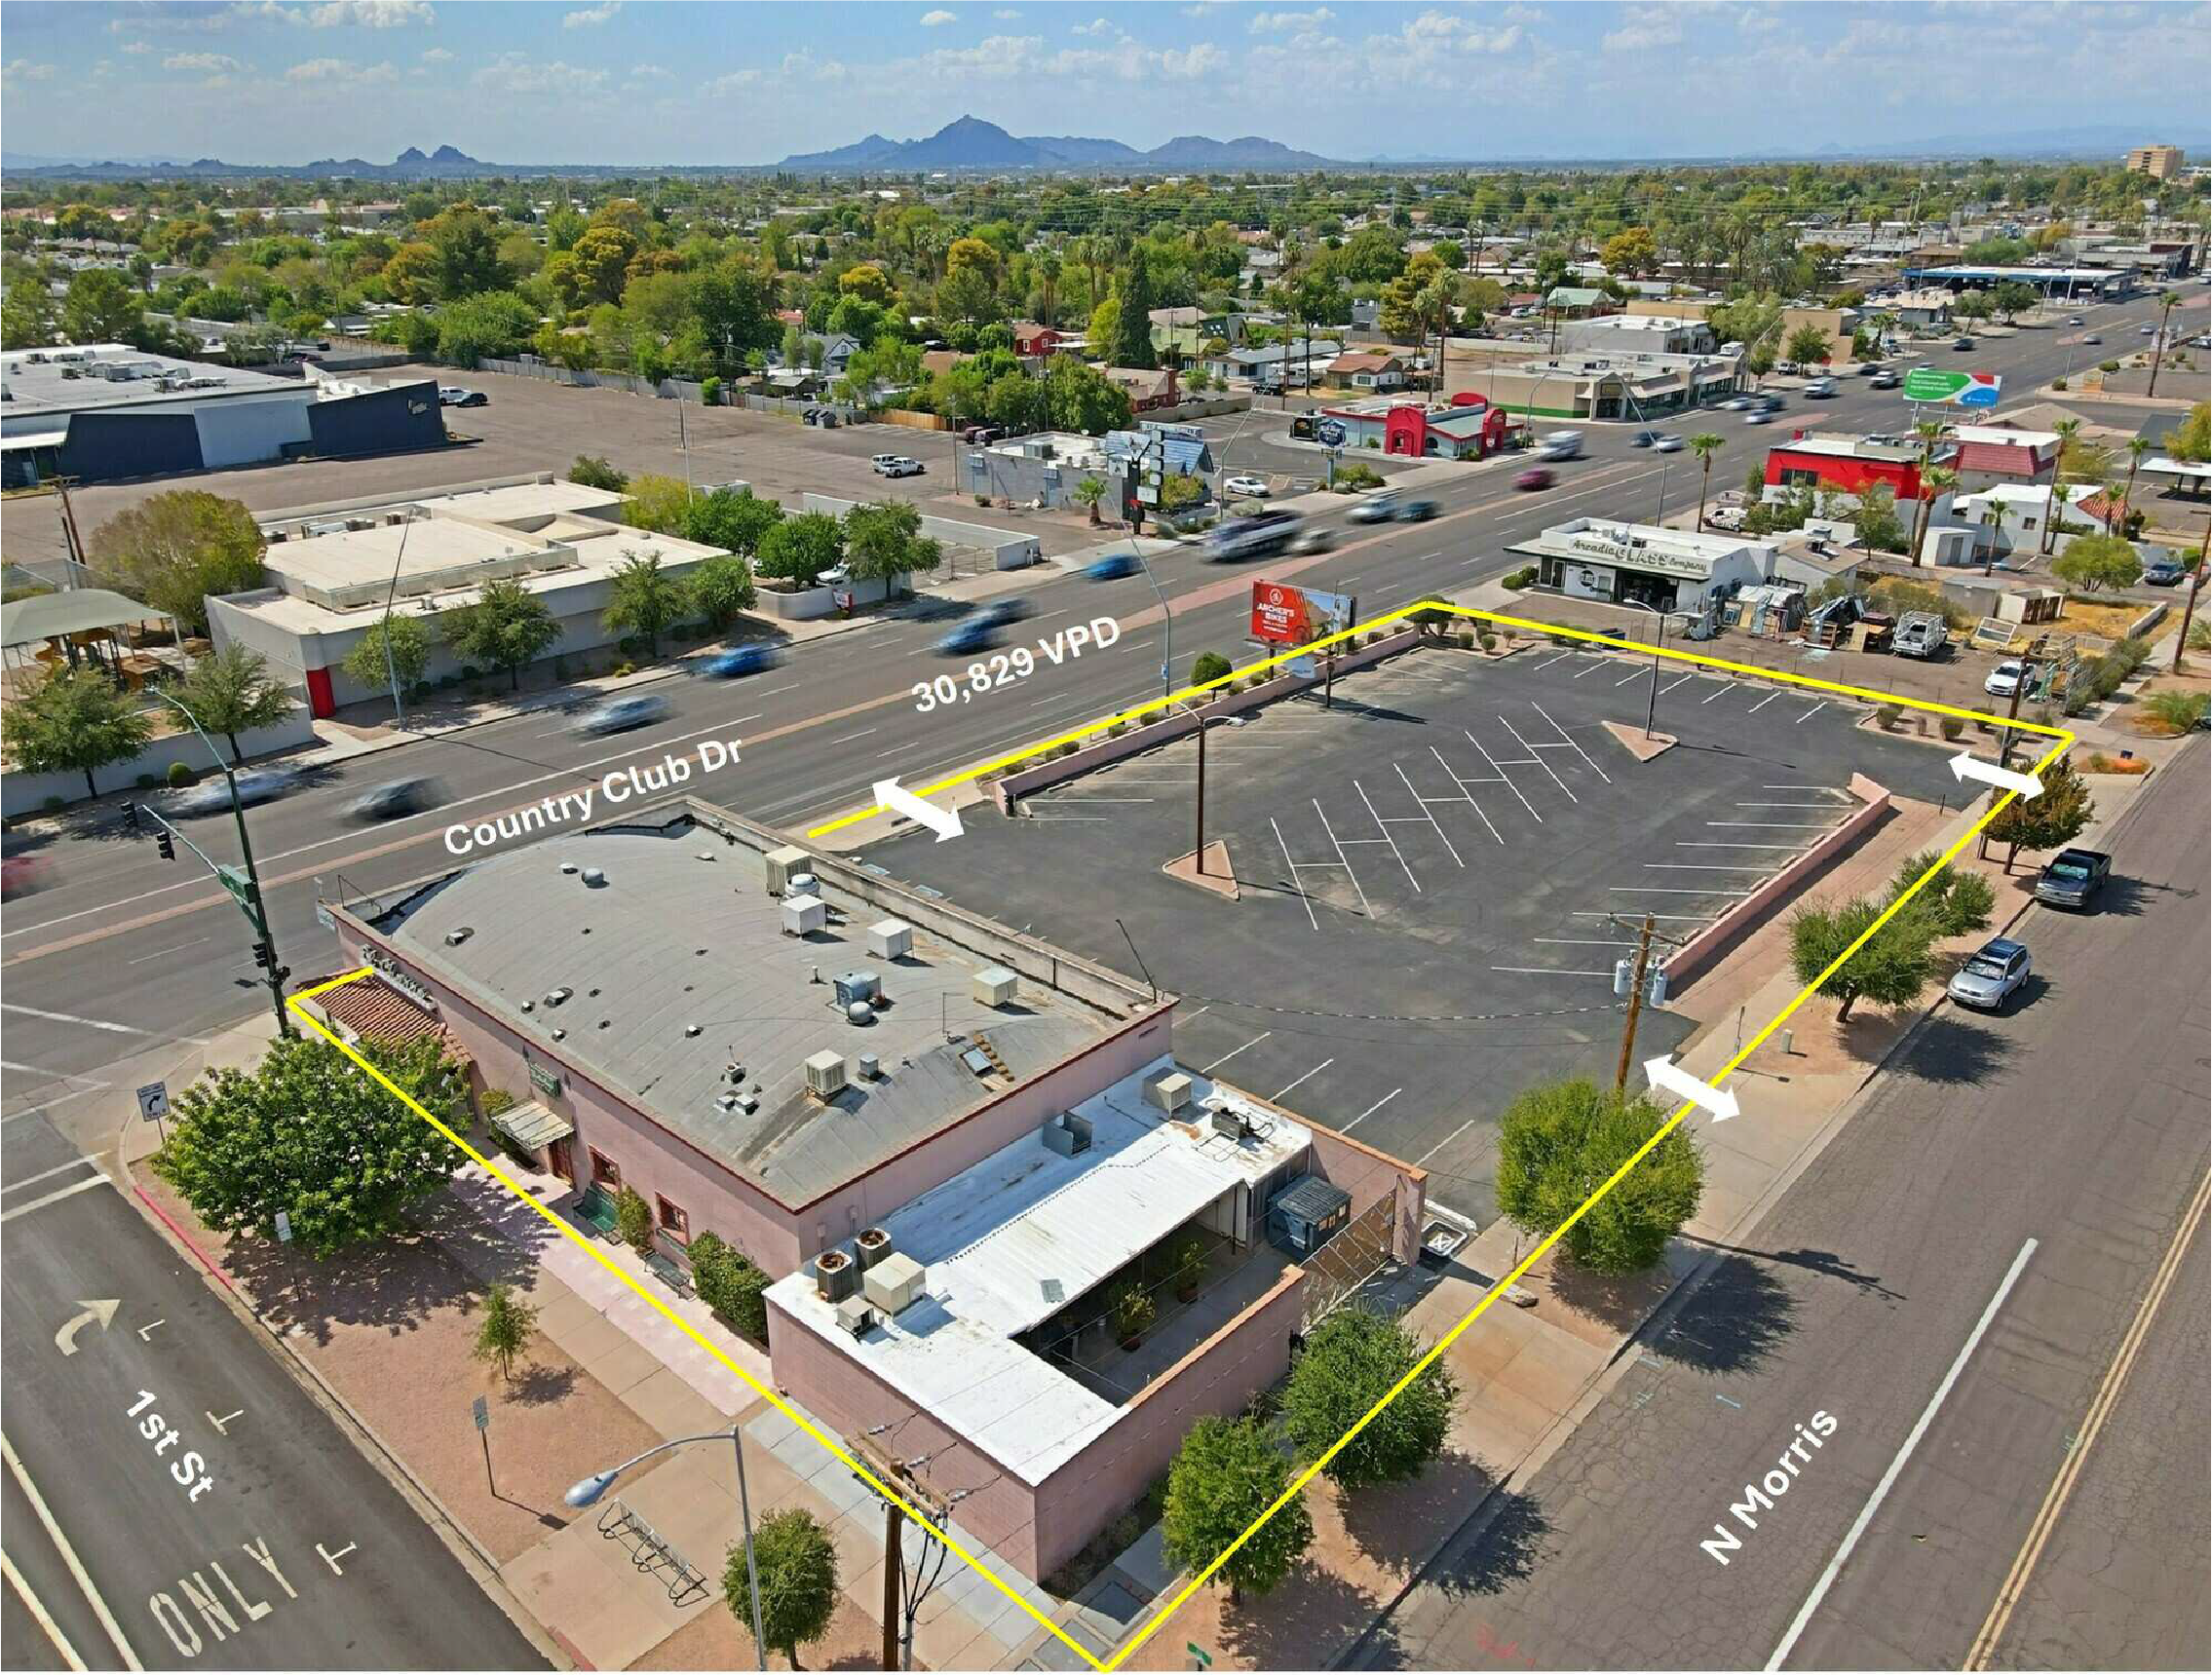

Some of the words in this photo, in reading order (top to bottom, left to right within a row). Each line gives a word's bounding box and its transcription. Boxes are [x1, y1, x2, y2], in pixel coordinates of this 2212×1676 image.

[1573, 540, 1616, 555] Arcadia
[1614, 547, 1668, 567] GLASS
[1667, 556, 1708, 573] Company
[1264, 612, 1288, 625] BIKES
[149, 1536, 299, 1657] ONLY
